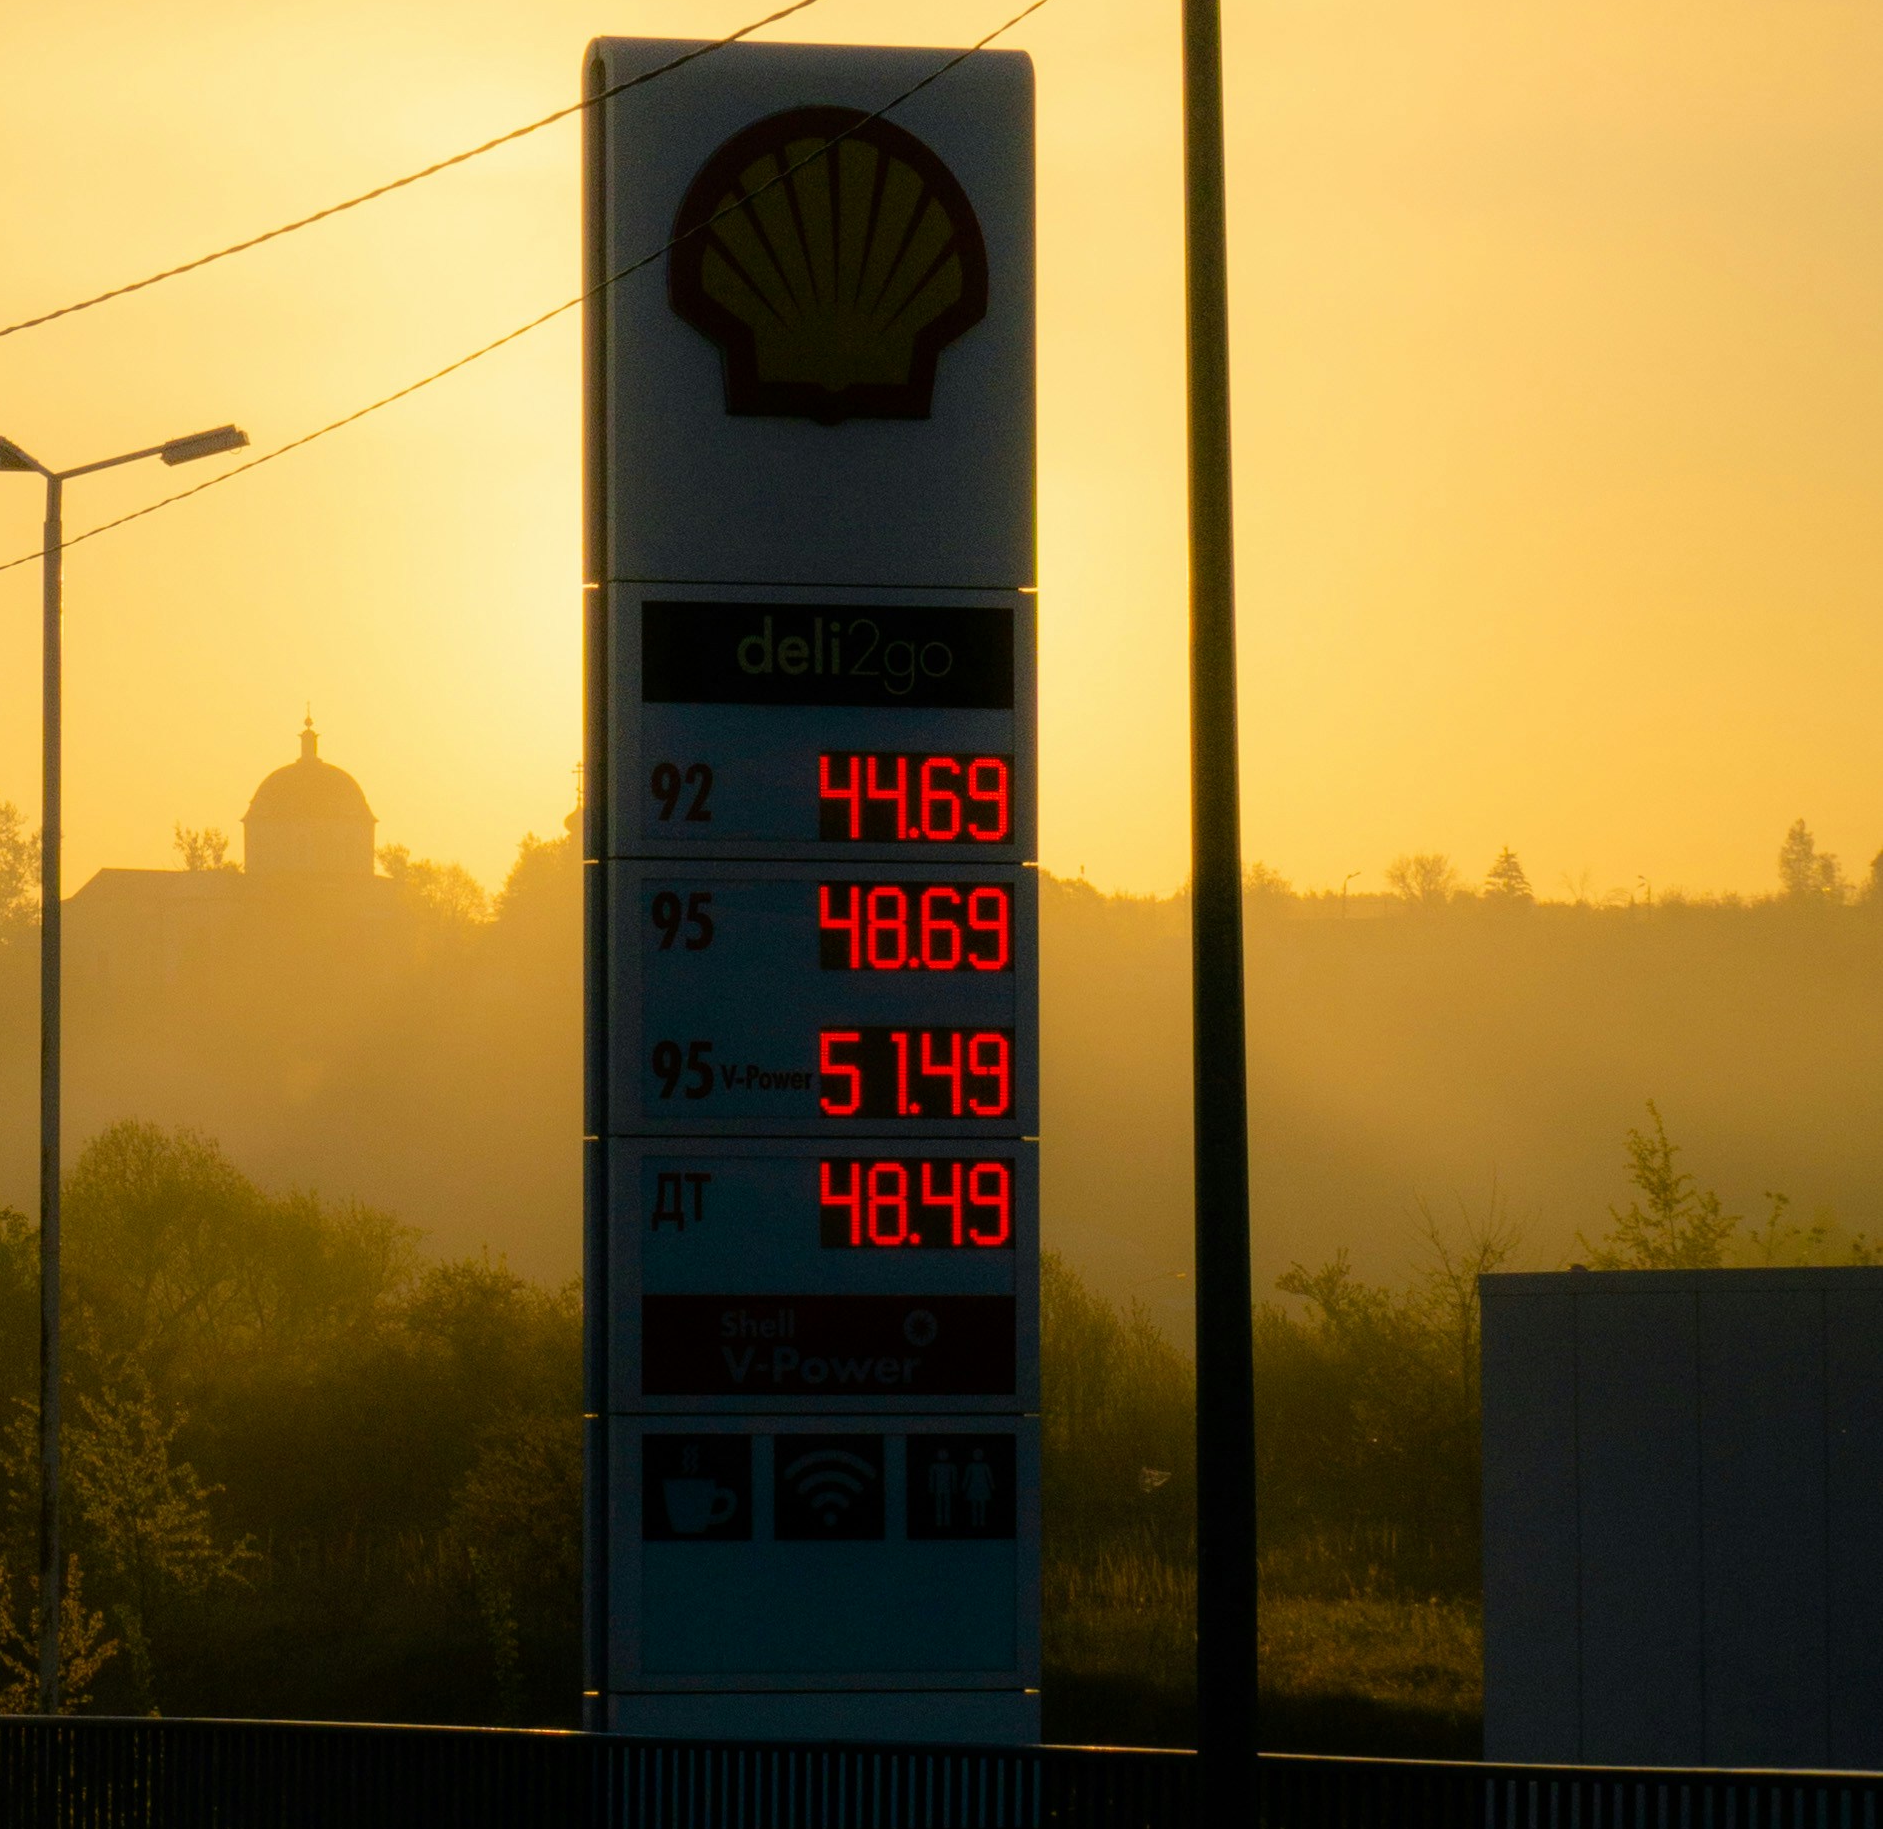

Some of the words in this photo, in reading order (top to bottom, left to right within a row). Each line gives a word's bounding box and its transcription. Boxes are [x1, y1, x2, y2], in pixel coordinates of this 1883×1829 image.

[736, 614, 953, 696] deli2go
[651, 763, 713, 821] 92
[819, 755, 1009, 841] 44.69
[652, 891, 714, 951] 95
[819, 884, 1010, 971] 48.69
[652, 1040, 714, 1099] 95
[721, 1064, 814, 1092] V-Power
[819, 1031, 1010, 1116] 51.49
[651, 1173, 712, 1232] ДТ
[820, 1161, 1010, 1247] 48.49
[721, 1308, 796, 1339] Shell
[721, 1344, 922, 1385] V-Power
